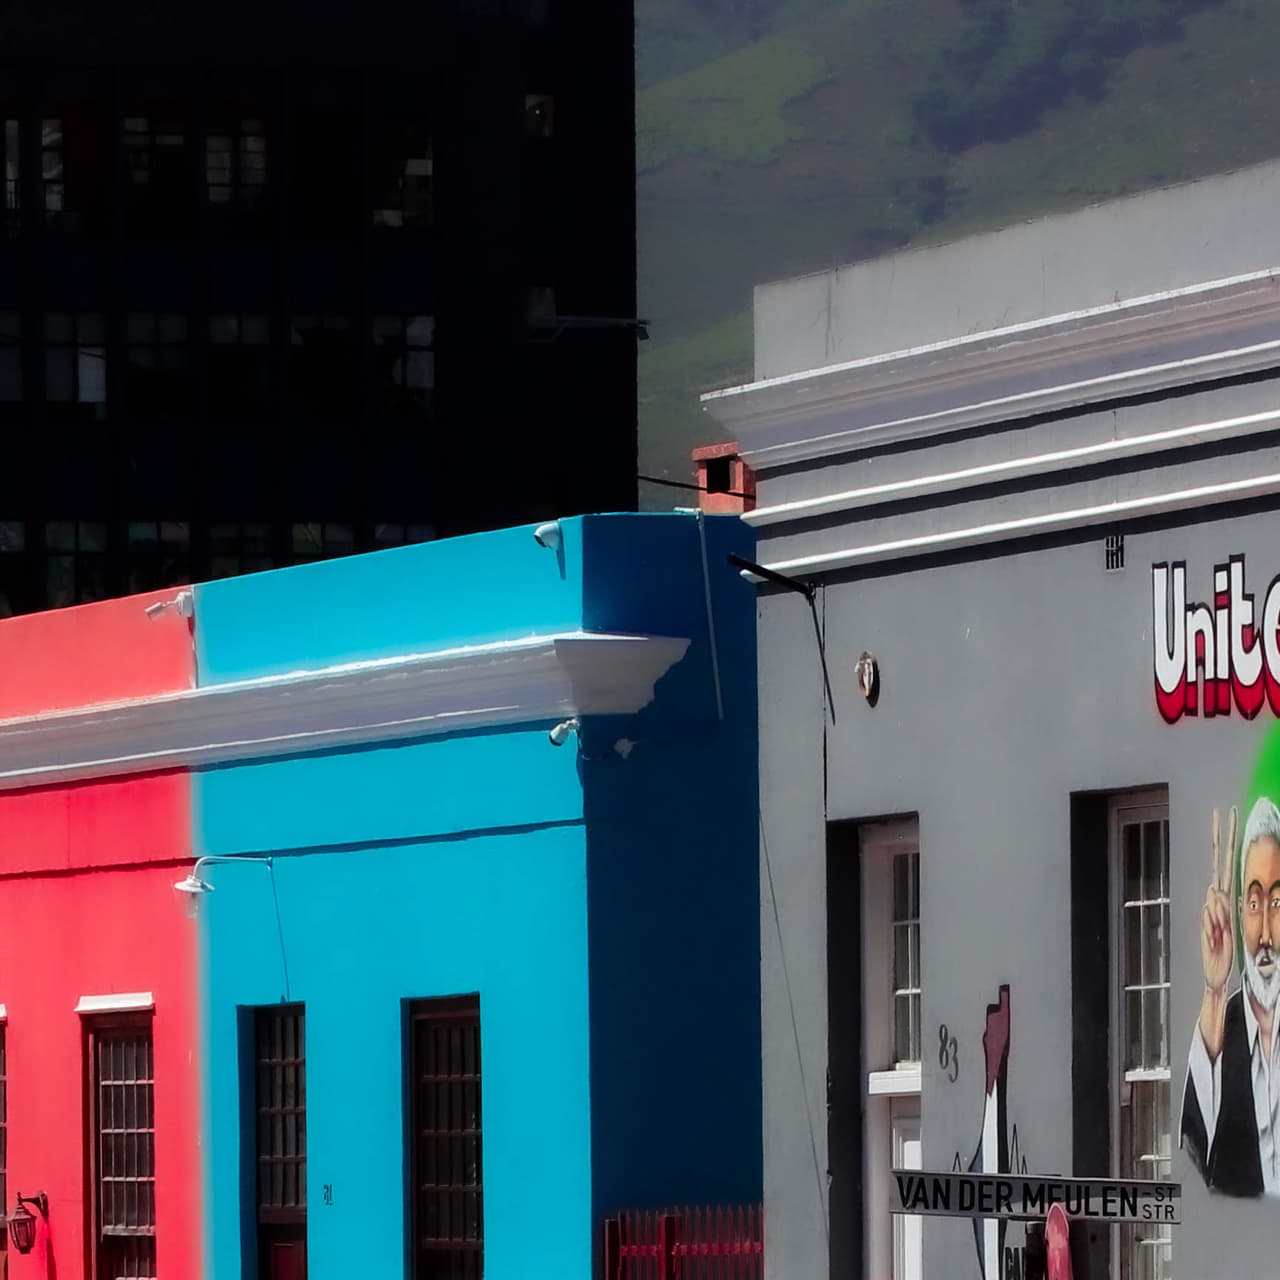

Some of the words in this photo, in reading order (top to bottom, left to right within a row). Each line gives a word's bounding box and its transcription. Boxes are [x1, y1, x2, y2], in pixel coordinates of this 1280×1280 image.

[938, 1023, 959, 1084] 83
[895, 1175, 952, 1211] VAN
[959, 1178, 1014, 1213] DER
[1022, 1182, 1138, 1218] MEULEN
[1142, 1203, 1176, 1220] STR
